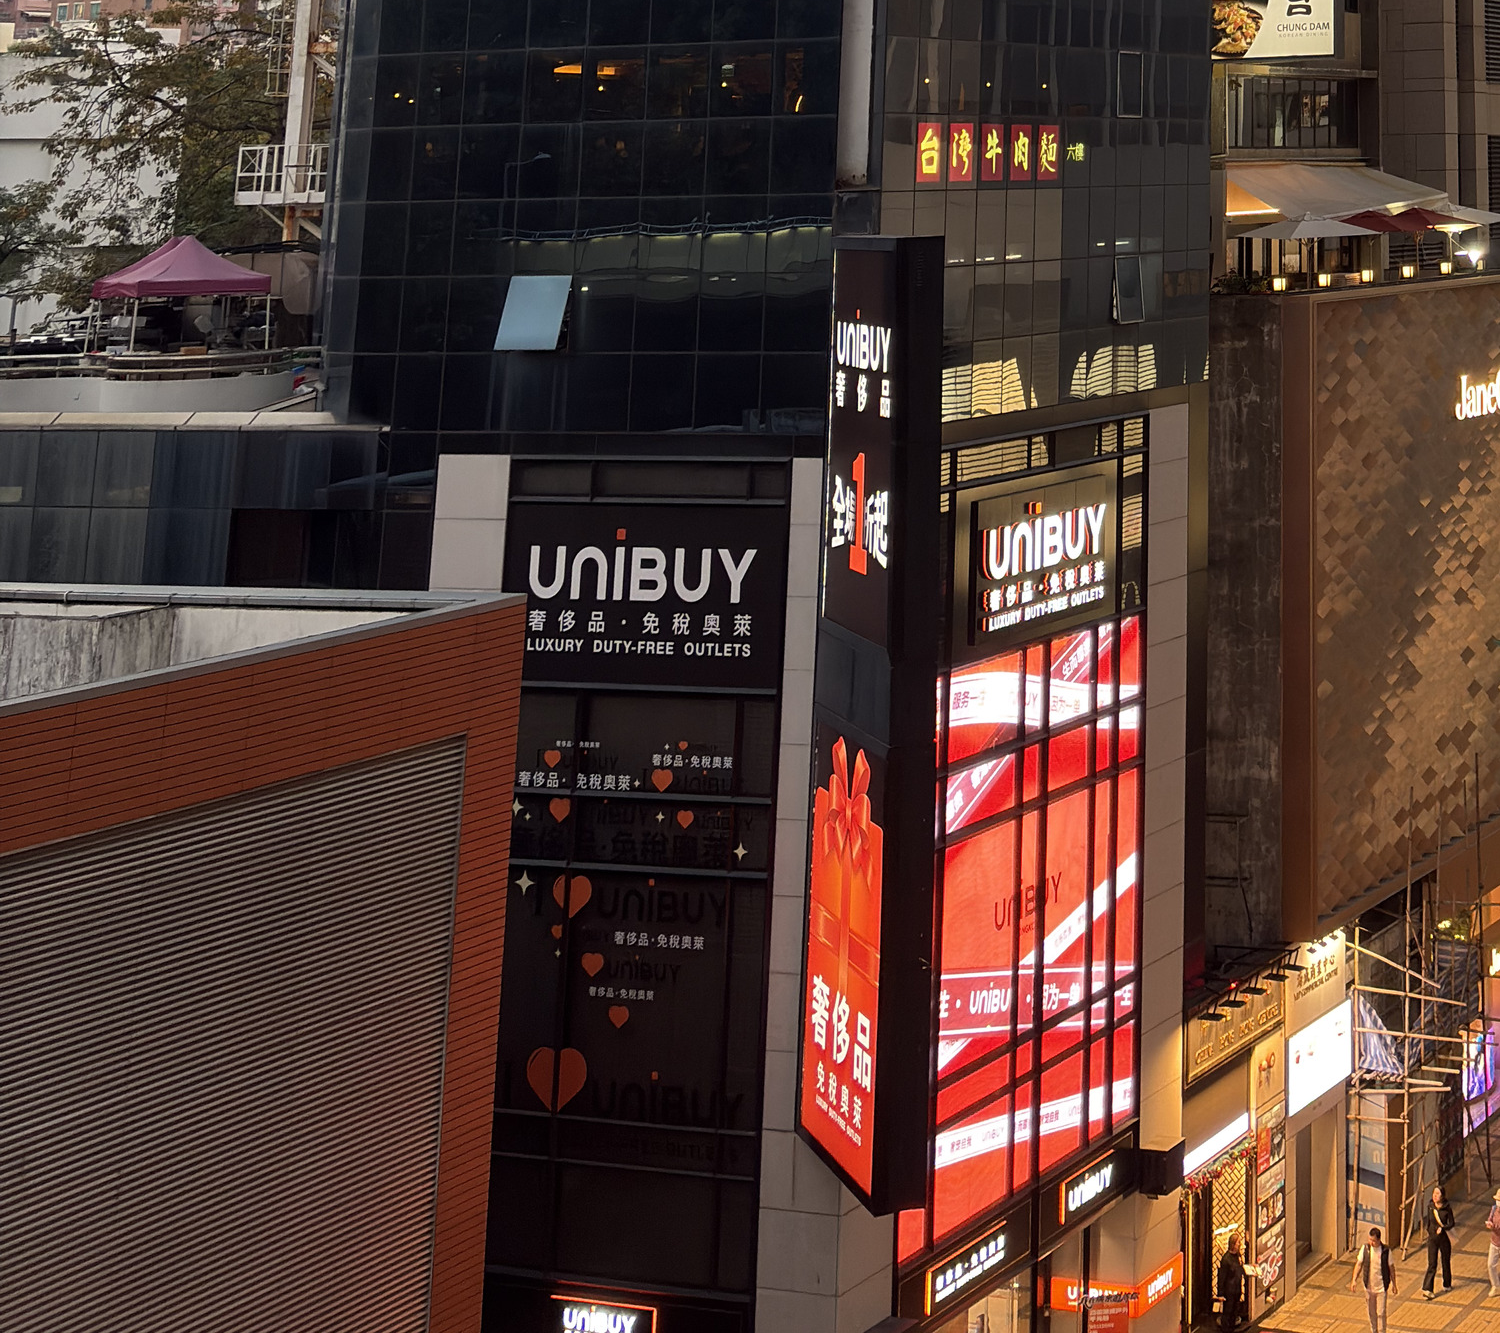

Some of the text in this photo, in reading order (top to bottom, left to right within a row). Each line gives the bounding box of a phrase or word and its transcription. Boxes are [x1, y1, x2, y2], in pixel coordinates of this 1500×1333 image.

[1276, 22, 1330, 32] CHUNG DAM
[1066, 142, 1085, 161] 六樓
[836, 309, 892, 374] UNIBUY
[836, 370, 891, 419] 奢侈品
[984, 502, 1107, 581] UNIBUY
[529, 528, 757, 604] UNIBUY
[528, 609, 752, 637] 奢侈品·免稅奧萊
[988, 610, 1021, 631] LUXURY
[1070, 585, 1105, 607] OUTLETS
[526, 638, 751, 658] LUXURY DUTY-FREE OUTLETS
[969, 982, 1011, 1015] UNIBU
[811, 974, 872, 1093] 奢侈品
[1068, 1162, 1114, 1212] UNIBUY
[562, 1304, 637, 1333] UNIBUY
